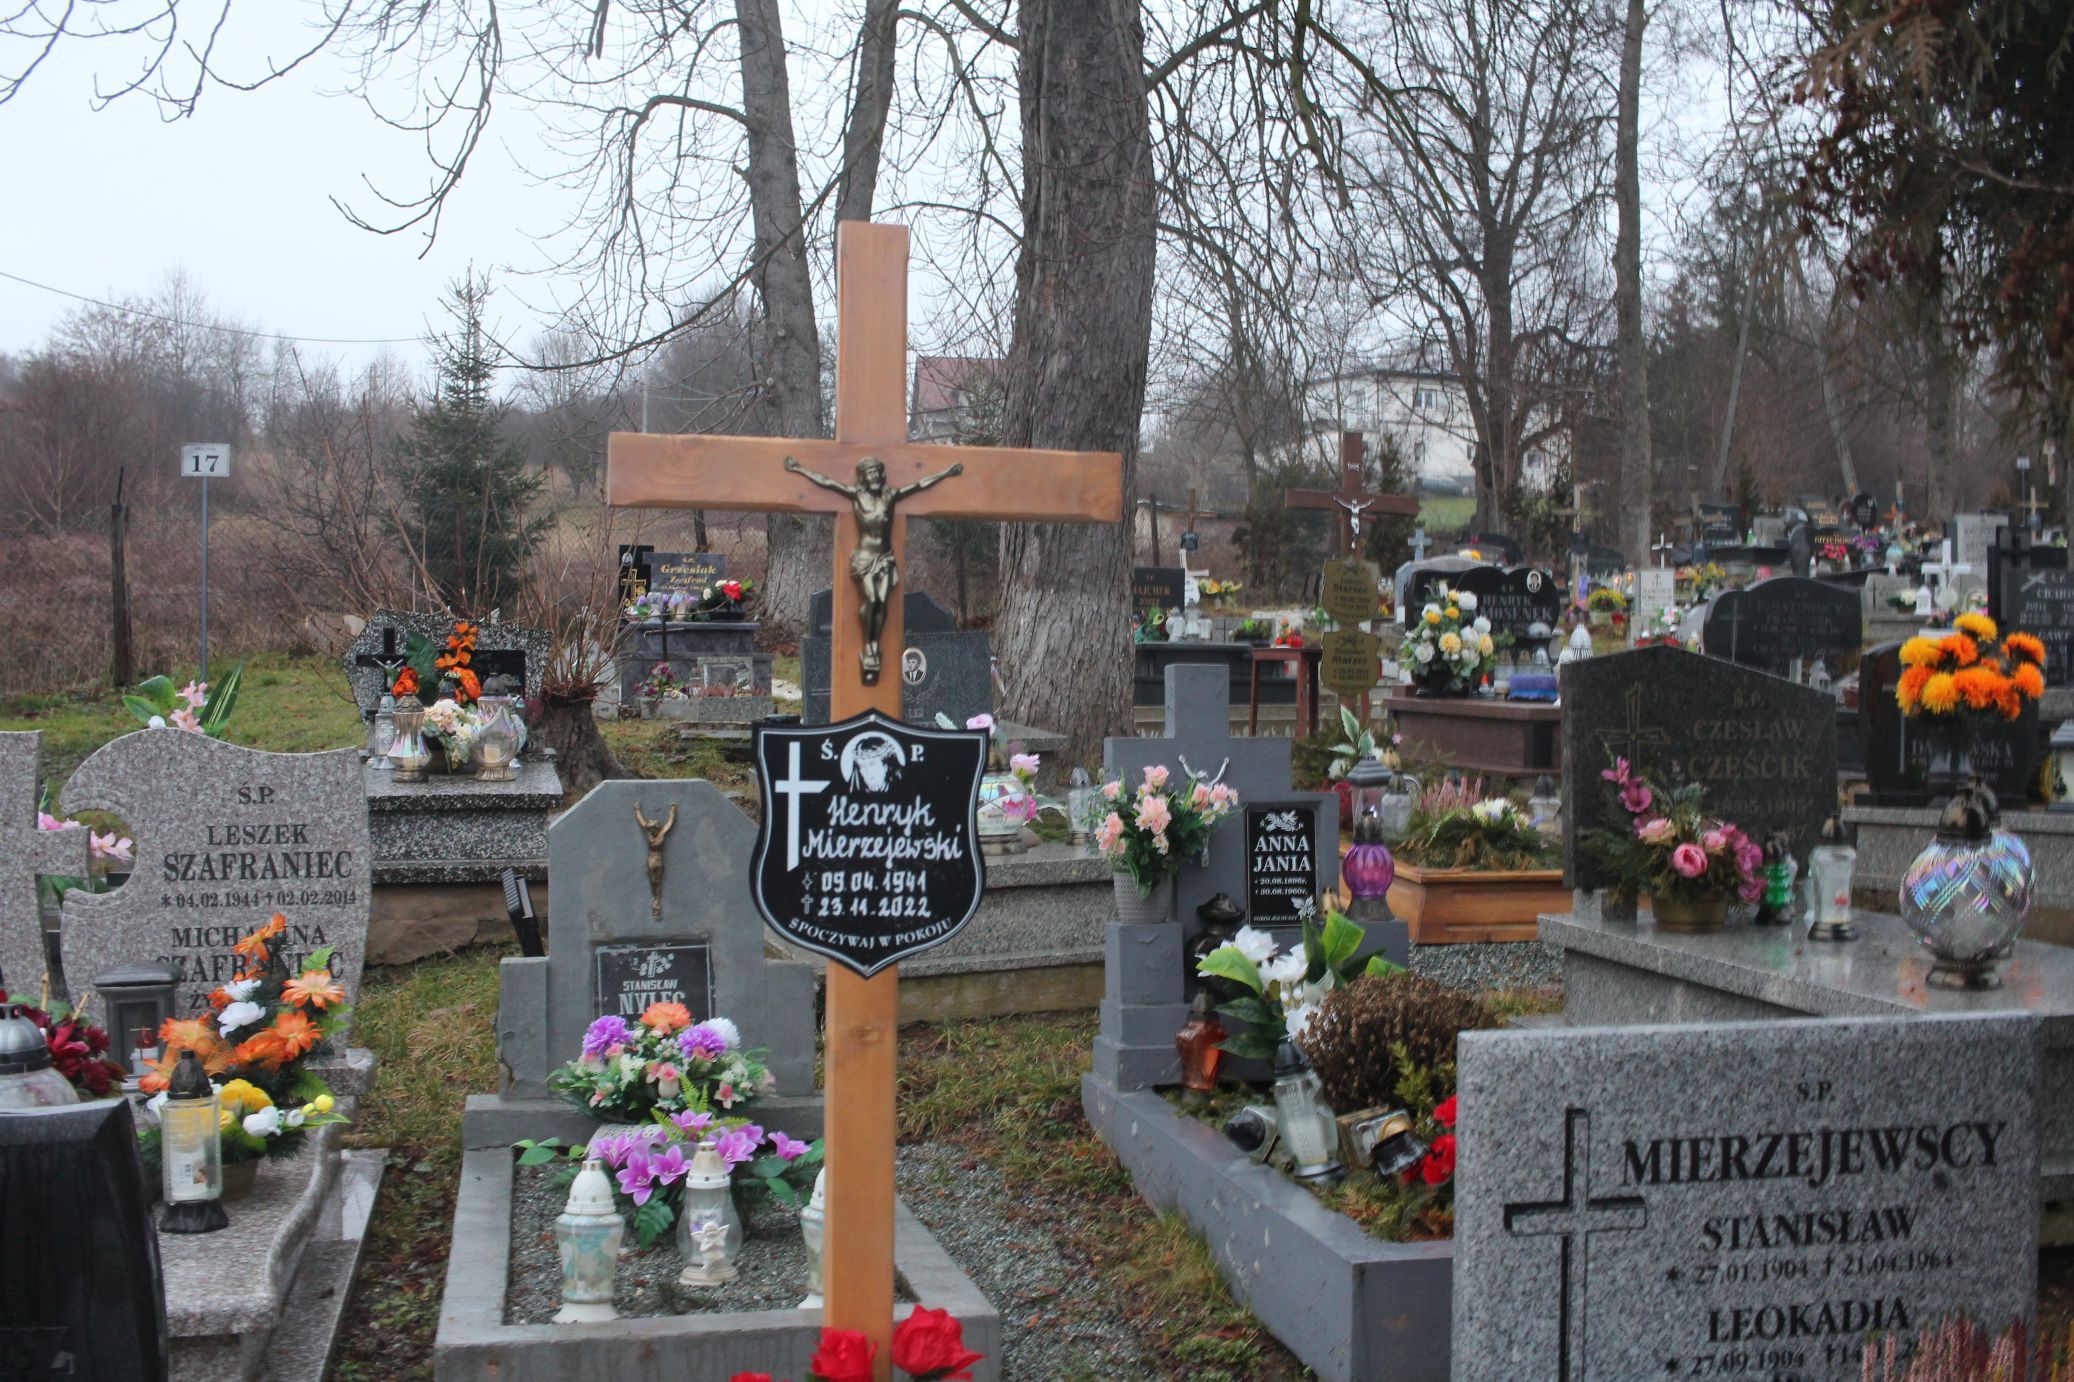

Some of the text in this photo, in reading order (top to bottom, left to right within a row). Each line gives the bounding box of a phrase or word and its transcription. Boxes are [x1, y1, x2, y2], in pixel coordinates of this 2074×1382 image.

[191, 455, 219, 472] 17
[821, 739, 924, 762] Ś. P.
[238, 783, 275, 804] Ś.P.
[827, 795, 935, 838] Henryk
[206, 823, 310, 846] LESZEK
[802, 824, 963, 868] Mierzejewski
[1254, 835, 1311, 852] ANNA
[163, 850, 353, 882] SZAFRANIEC
[1253, 854, 1311, 872] JANIA
[175, 892, 259, 908] 04.02.1944
[171, 924, 327, 948] MICHNA
[788, 917, 951, 949] SPOCZYWAJ W POKOJU
[1621, 1121, 2007, 1188] MIERZEJEWSCY
[1702, 1206, 1921, 1252] STANISŁAW
[1708, 1297, 1910, 1343] LEOKADIA
